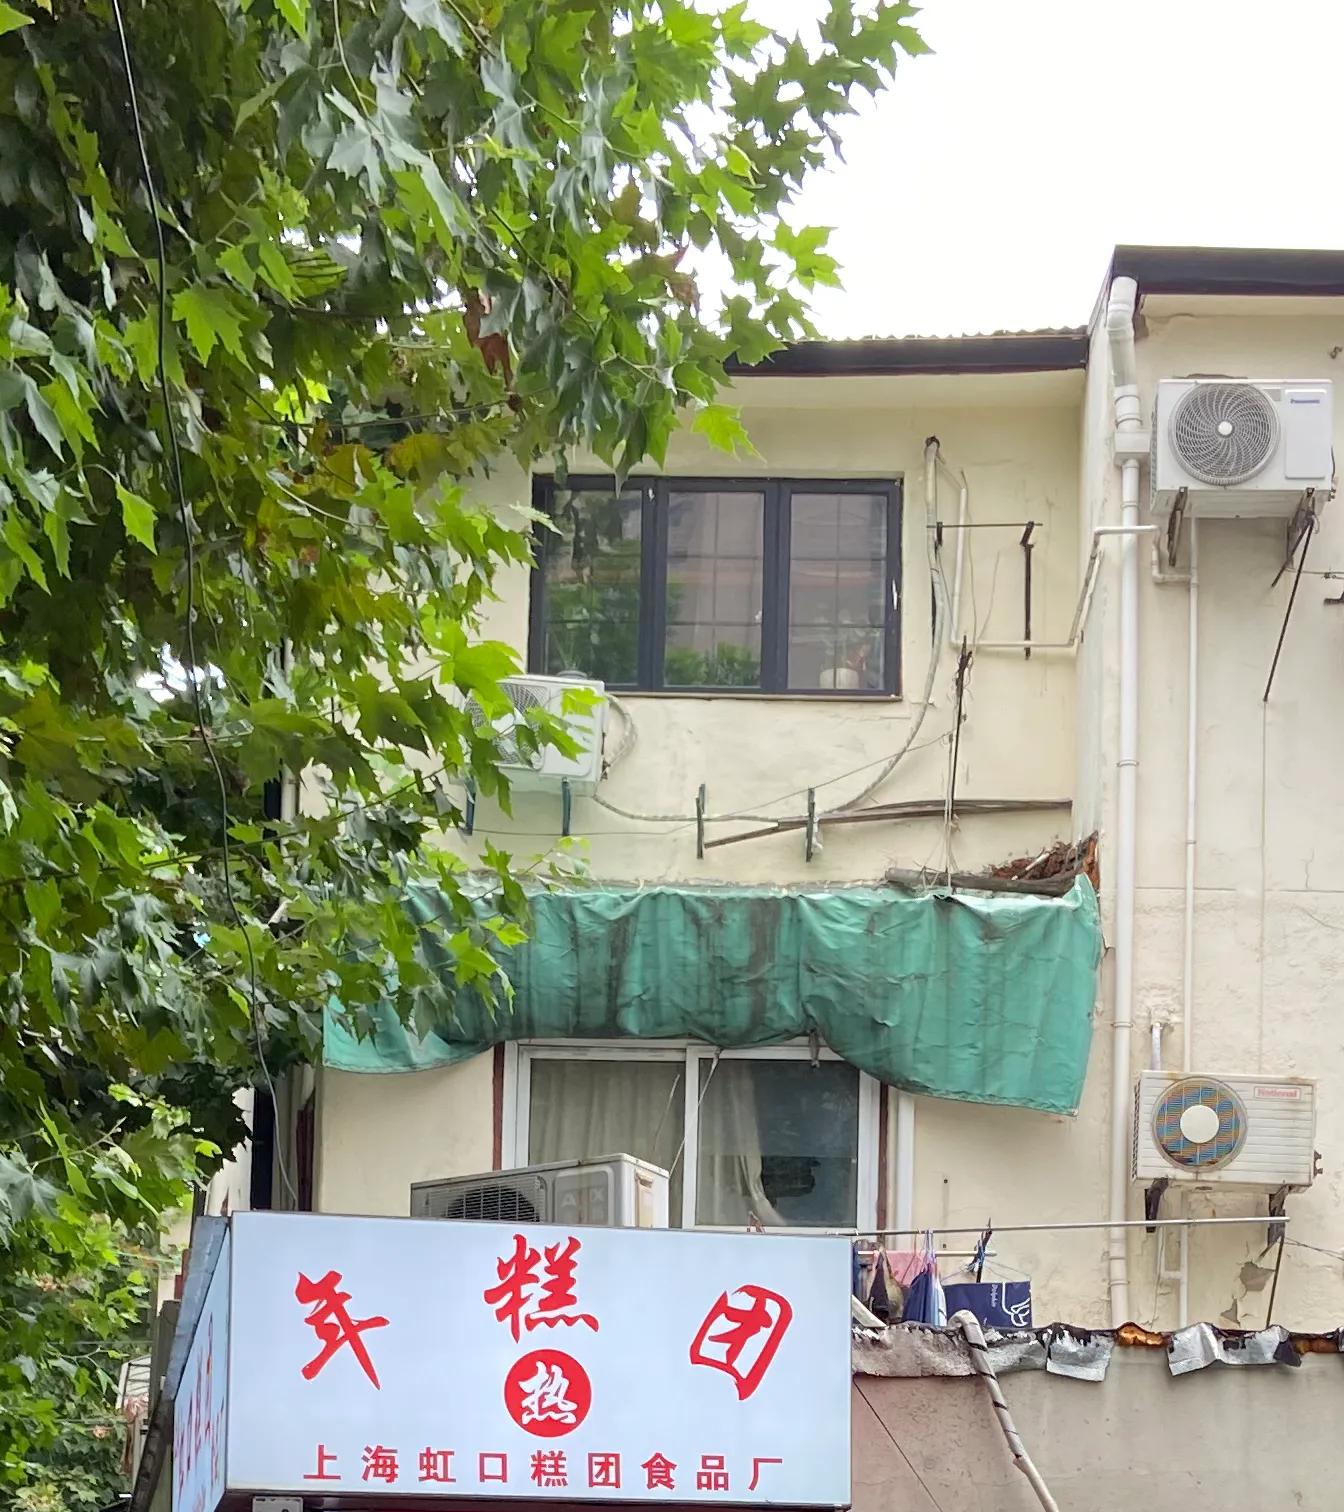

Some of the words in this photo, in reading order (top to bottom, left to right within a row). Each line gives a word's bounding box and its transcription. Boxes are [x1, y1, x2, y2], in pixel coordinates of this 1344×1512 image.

[516, 1361, 578, 1427] 热
[302, 1443, 784, 1493] 上海虹口糕团食品厂
